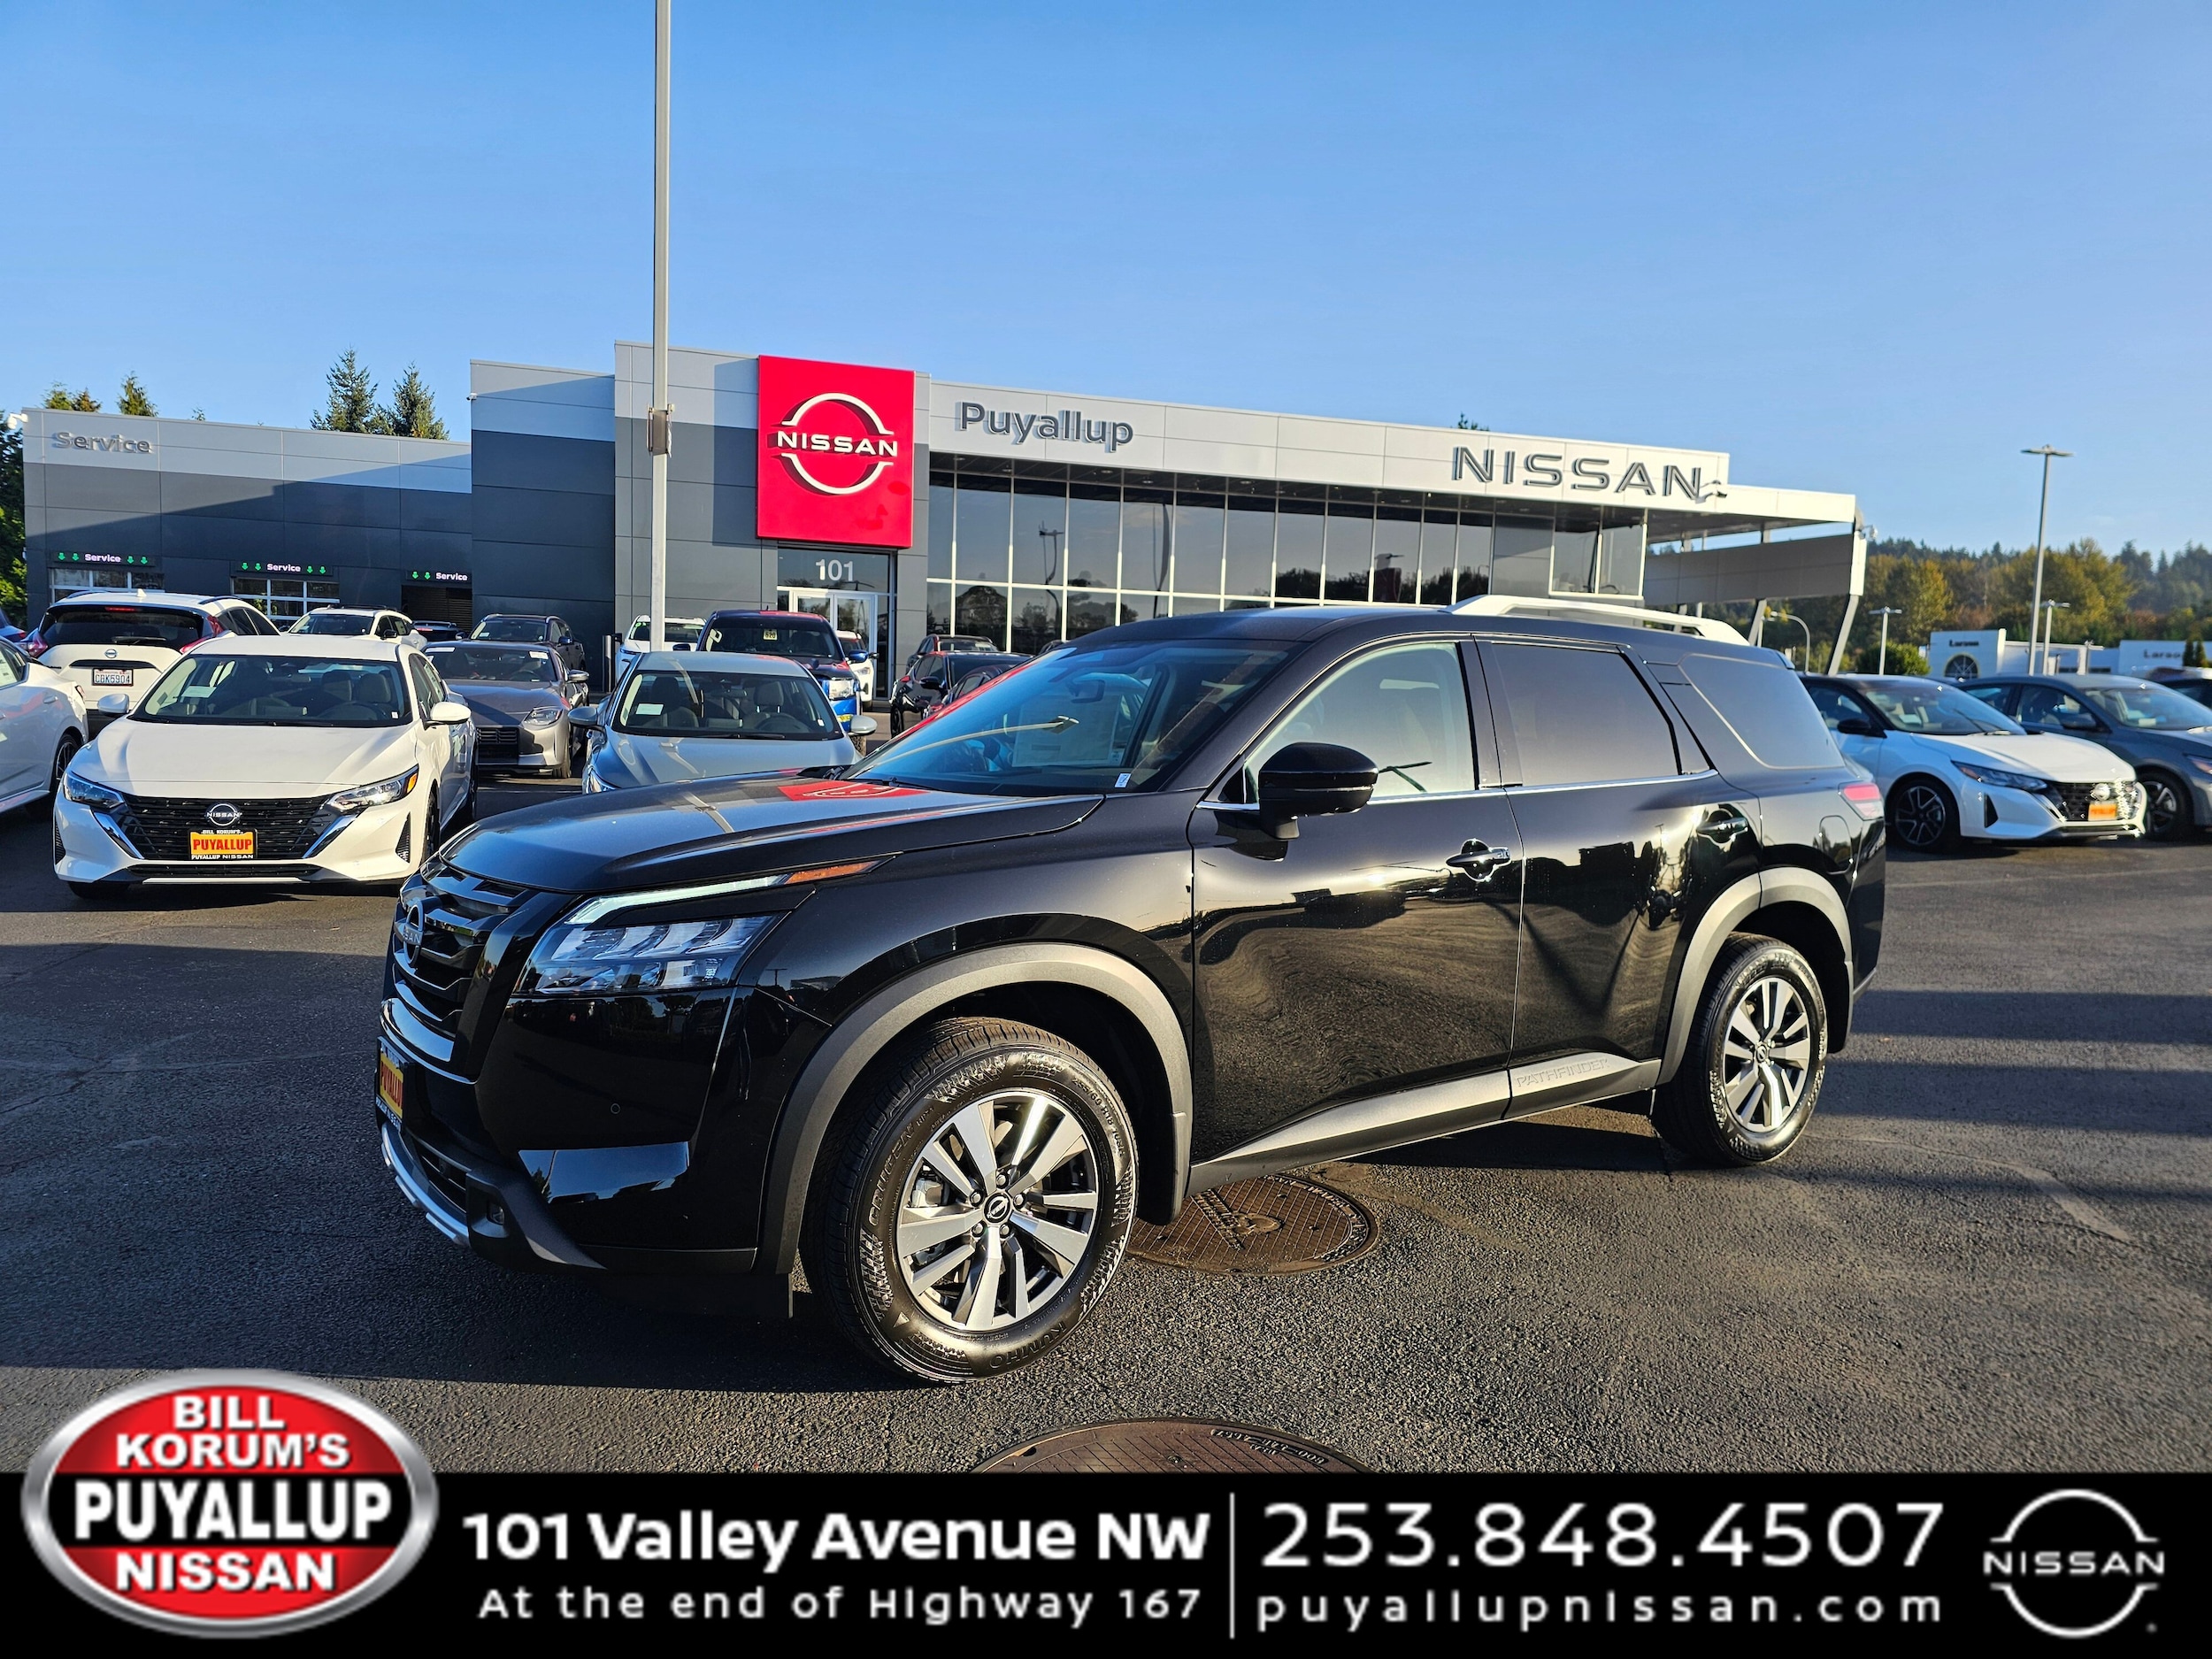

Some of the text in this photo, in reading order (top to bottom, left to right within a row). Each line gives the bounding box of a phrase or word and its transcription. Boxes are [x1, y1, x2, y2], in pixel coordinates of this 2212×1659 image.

[960, 402, 1133, 453] Puyallup
[53, 431, 152, 454] Service
[777, 430, 897, 457] NISSAN
[1452, 446, 1701, 501] NISSAN
[84, 553, 121, 564] Service
[266, 563, 302, 572] Service
[815, 559, 856, 581] 101
[435, 572, 468, 581] Service
[193, 839, 252, 850] PUYALLUP
[1515, 1058, 1609, 1087] PATHFINDER
[988, 1320, 1067, 1370] KUMHO
